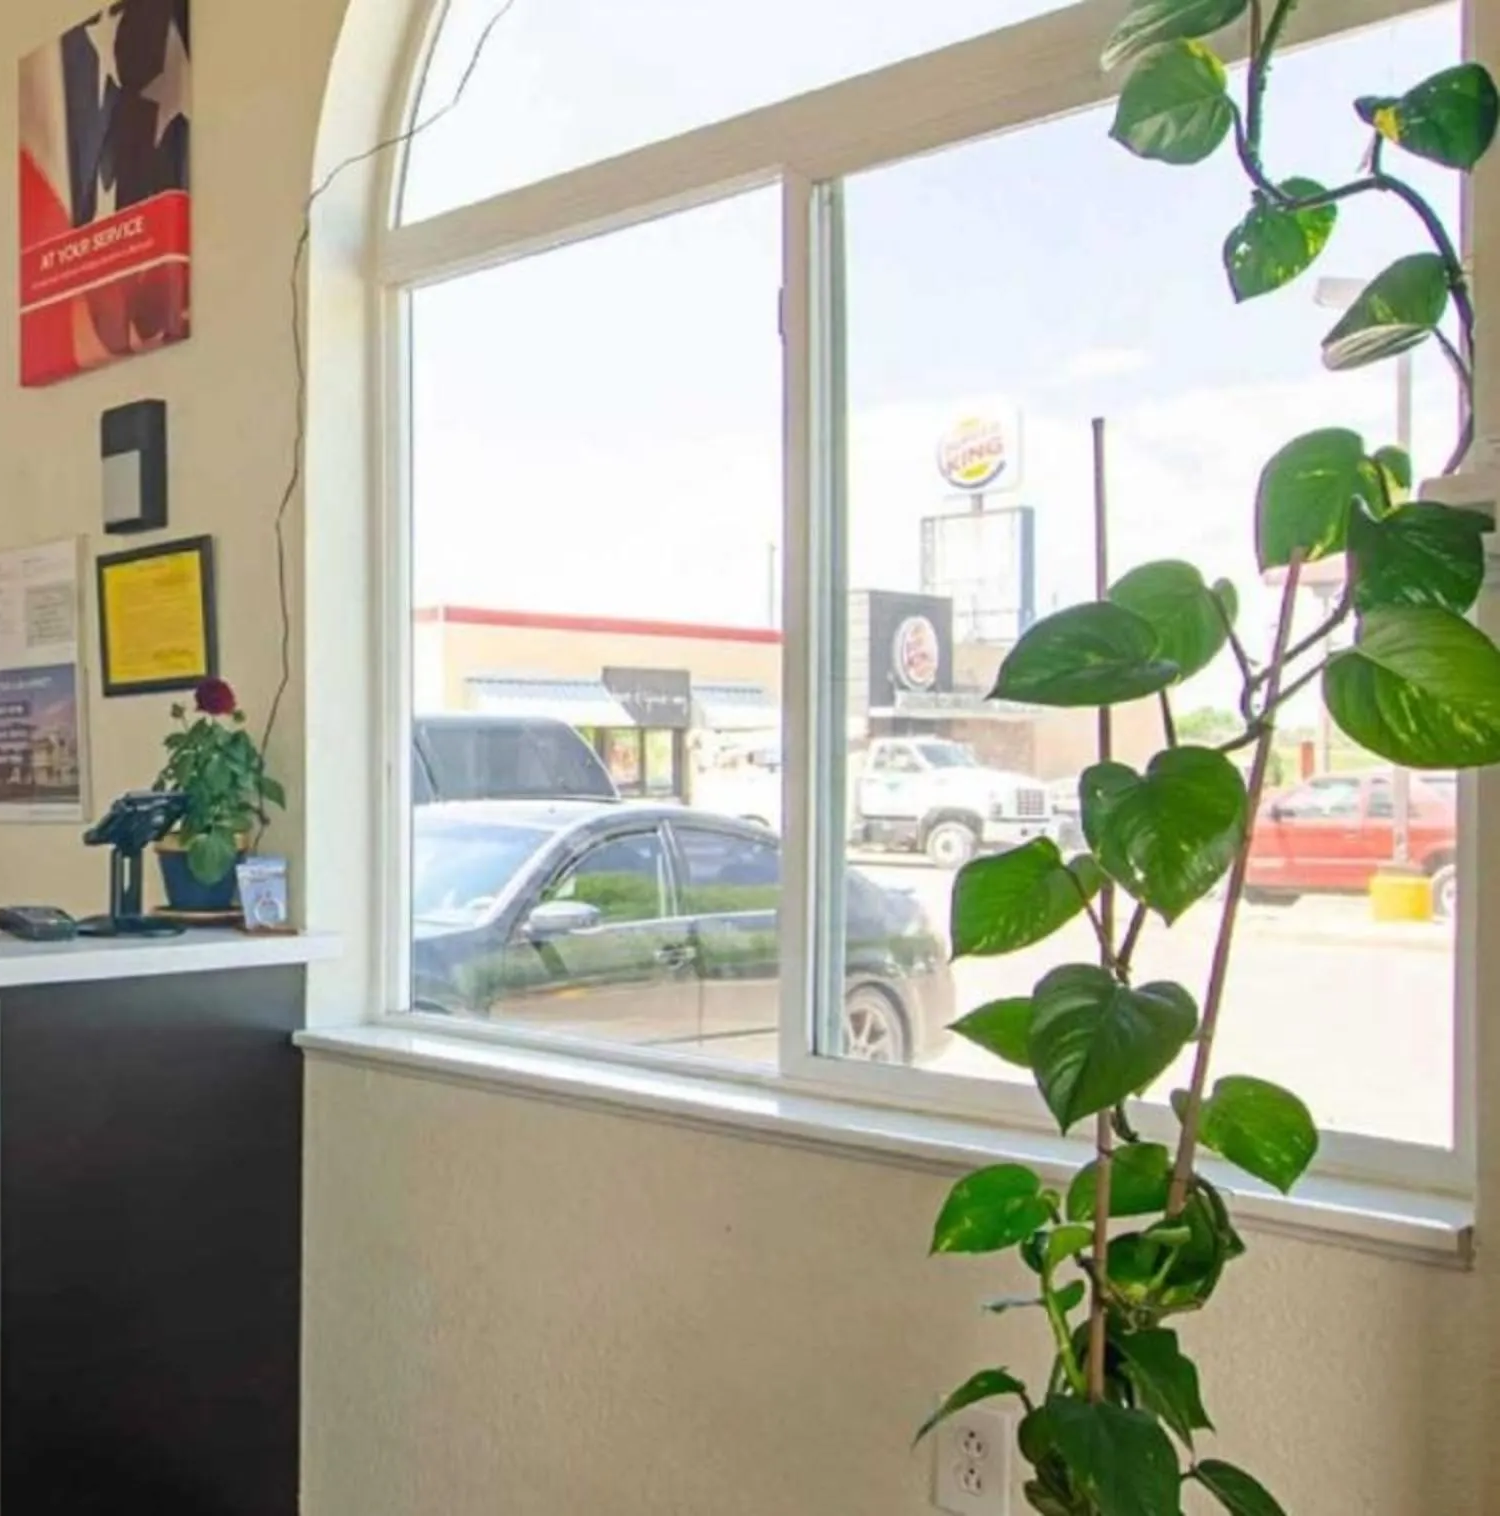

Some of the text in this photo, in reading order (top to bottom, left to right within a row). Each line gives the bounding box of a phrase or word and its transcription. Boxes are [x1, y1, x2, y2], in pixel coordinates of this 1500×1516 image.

[40, 250, 55, 271] AT
[57, 237, 91, 264] YOUR
[92, 215, 144, 251] SERVICE
